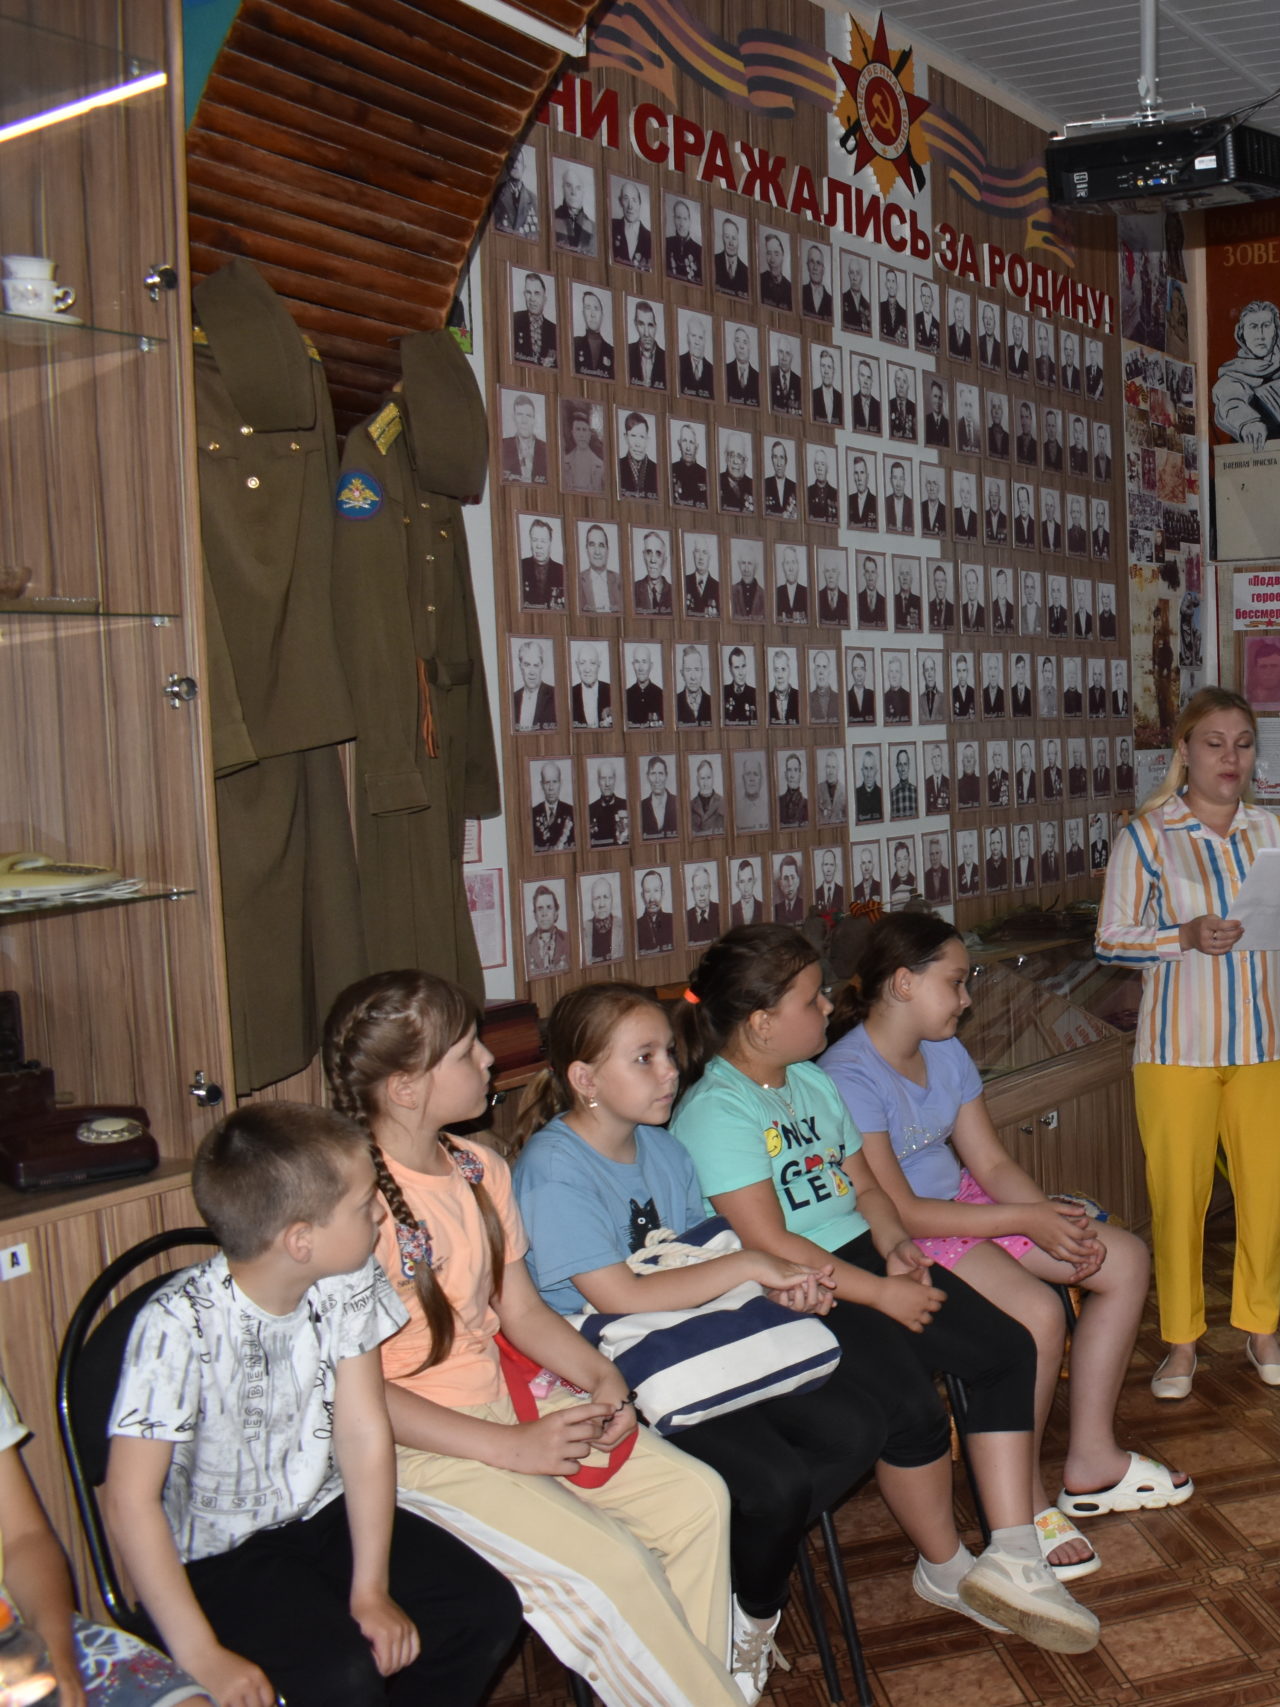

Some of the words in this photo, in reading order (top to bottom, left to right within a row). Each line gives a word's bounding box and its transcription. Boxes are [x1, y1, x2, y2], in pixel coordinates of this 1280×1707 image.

[629, 102, 931, 261] СРАЖАЛИСЬ
[935, 222, 981, 283] ЗА
[983, 242, 1114, 335] РОДИНУ!
[243, 1405, 264, 1444] LES
